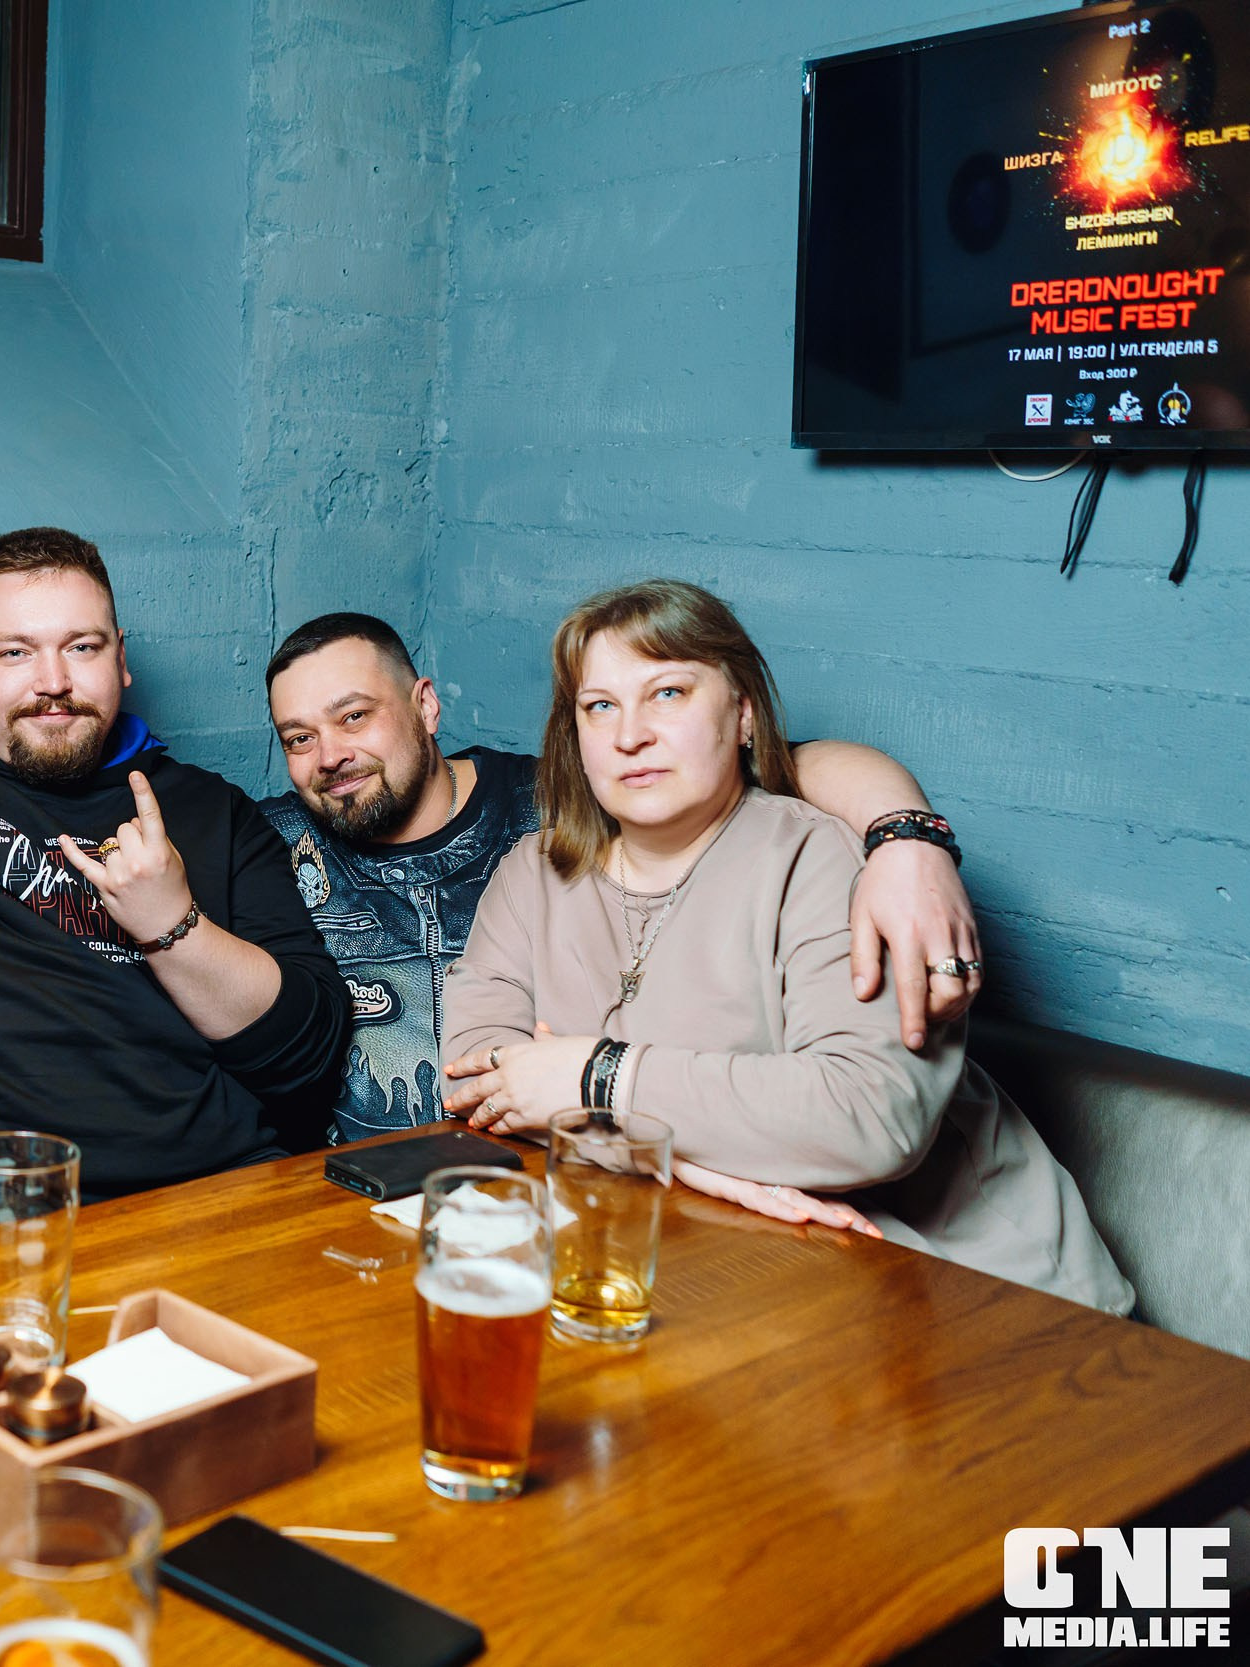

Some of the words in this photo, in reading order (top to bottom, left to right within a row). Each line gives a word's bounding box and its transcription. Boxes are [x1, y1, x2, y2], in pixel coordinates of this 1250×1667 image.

[1108, 21, 1137, 39] Part
[1140, 18, 1151, 34] 2
[1090, 74, 1163, 98] МИТОТС
[1184, 123, 1250, 147] RELIFE
[1004, 150, 1064, 171] ШИЗГА
[1076, 230, 1158, 251] ЛЕММИНГИ
[1011, 267, 1225, 307] DREADNOUGHT
[1031, 306, 1114, 335] MUSIC
[1120, 301, 1197, 331] FEST
[1008, 348, 1021, 361] 17
[1024, 347, 1054, 361] МАЯ
[1068, 345, 1107, 360] 19:00
[1207, 338, 1219, 354] 5
[1079, 369, 1104, 380] Вход
[1106, 368, 1128, 379] 300
